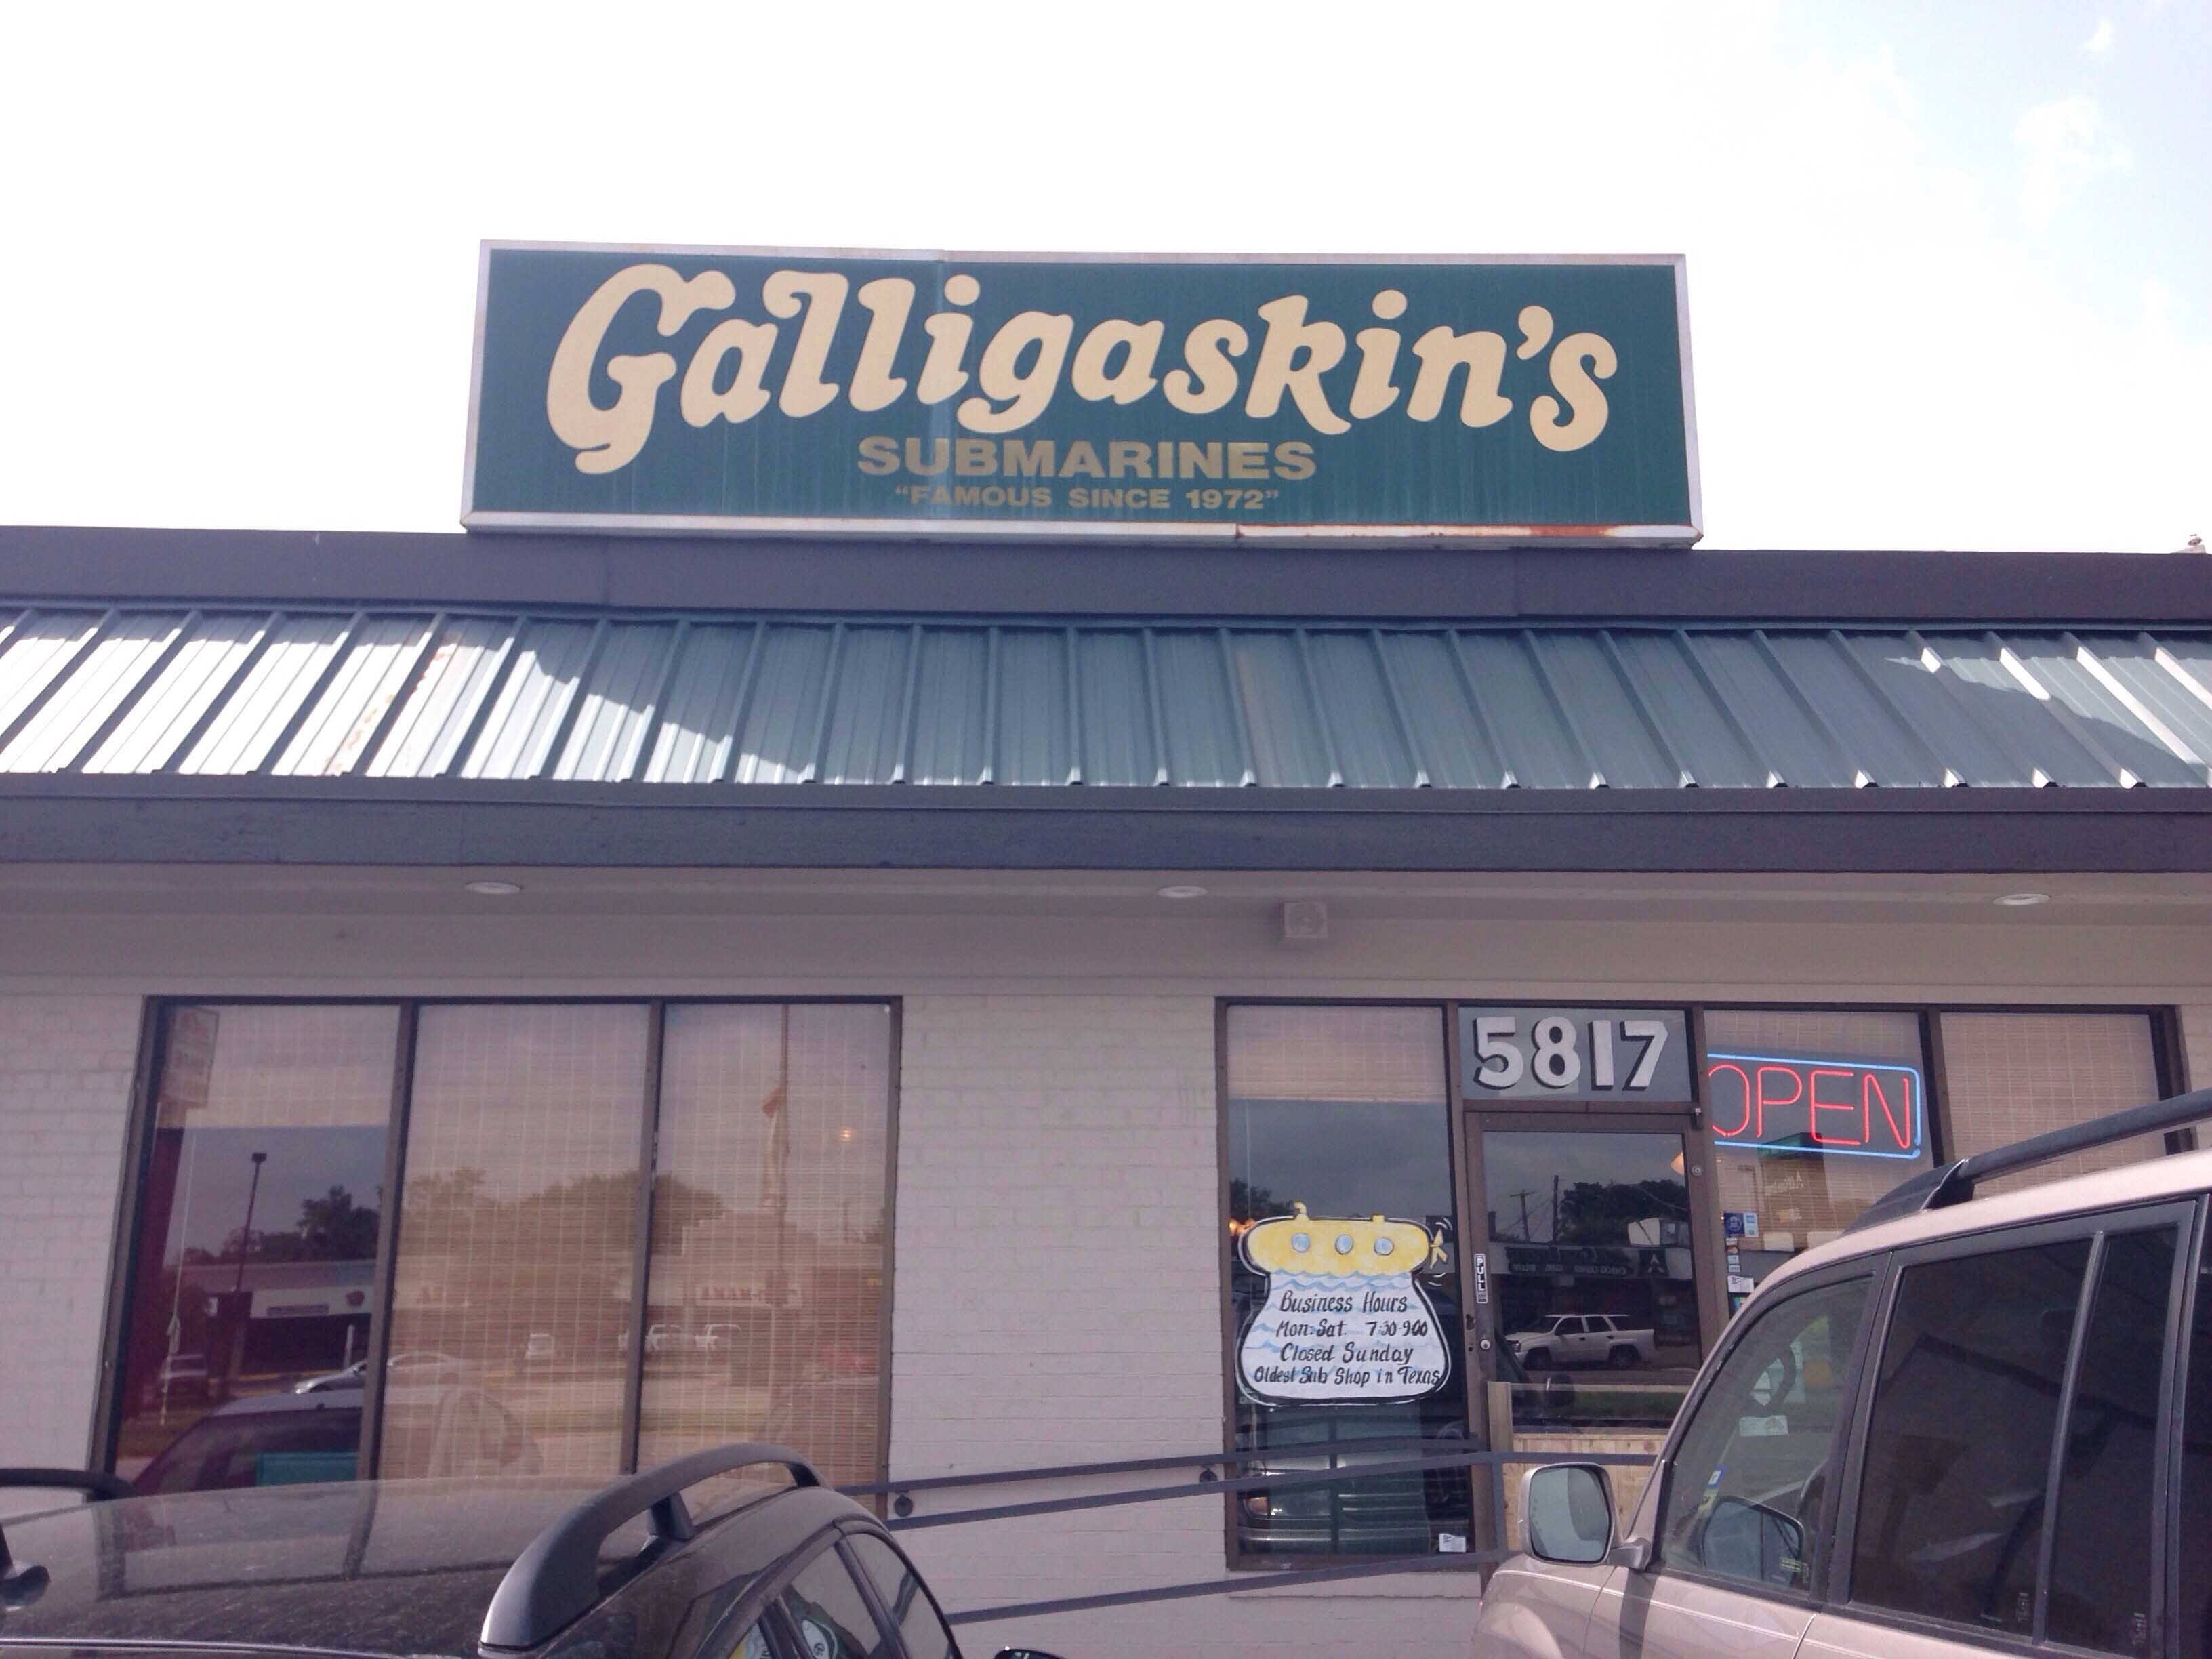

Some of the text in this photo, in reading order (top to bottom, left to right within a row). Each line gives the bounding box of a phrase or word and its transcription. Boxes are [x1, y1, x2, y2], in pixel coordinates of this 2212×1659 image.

[547, 263, 1618, 475] Galligaskin's
[857, 435, 1316, 480] SUBMARINES
[896, 485, 1278, 509] "FAMOUS SINCE 1972"
[1474, 1016, 1668, 1092] 5817
[1708, 1064, 1910, 1149] OPEN
[1477, 1258, 1485, 1291] PULL
[1279, 1290, 1408, 1313] Business Hours
[1279, 1340, 1414, 1366] Closed Sunday
[1254, 1366, 1440, 1389] Oldest Sub Shop in Texas
